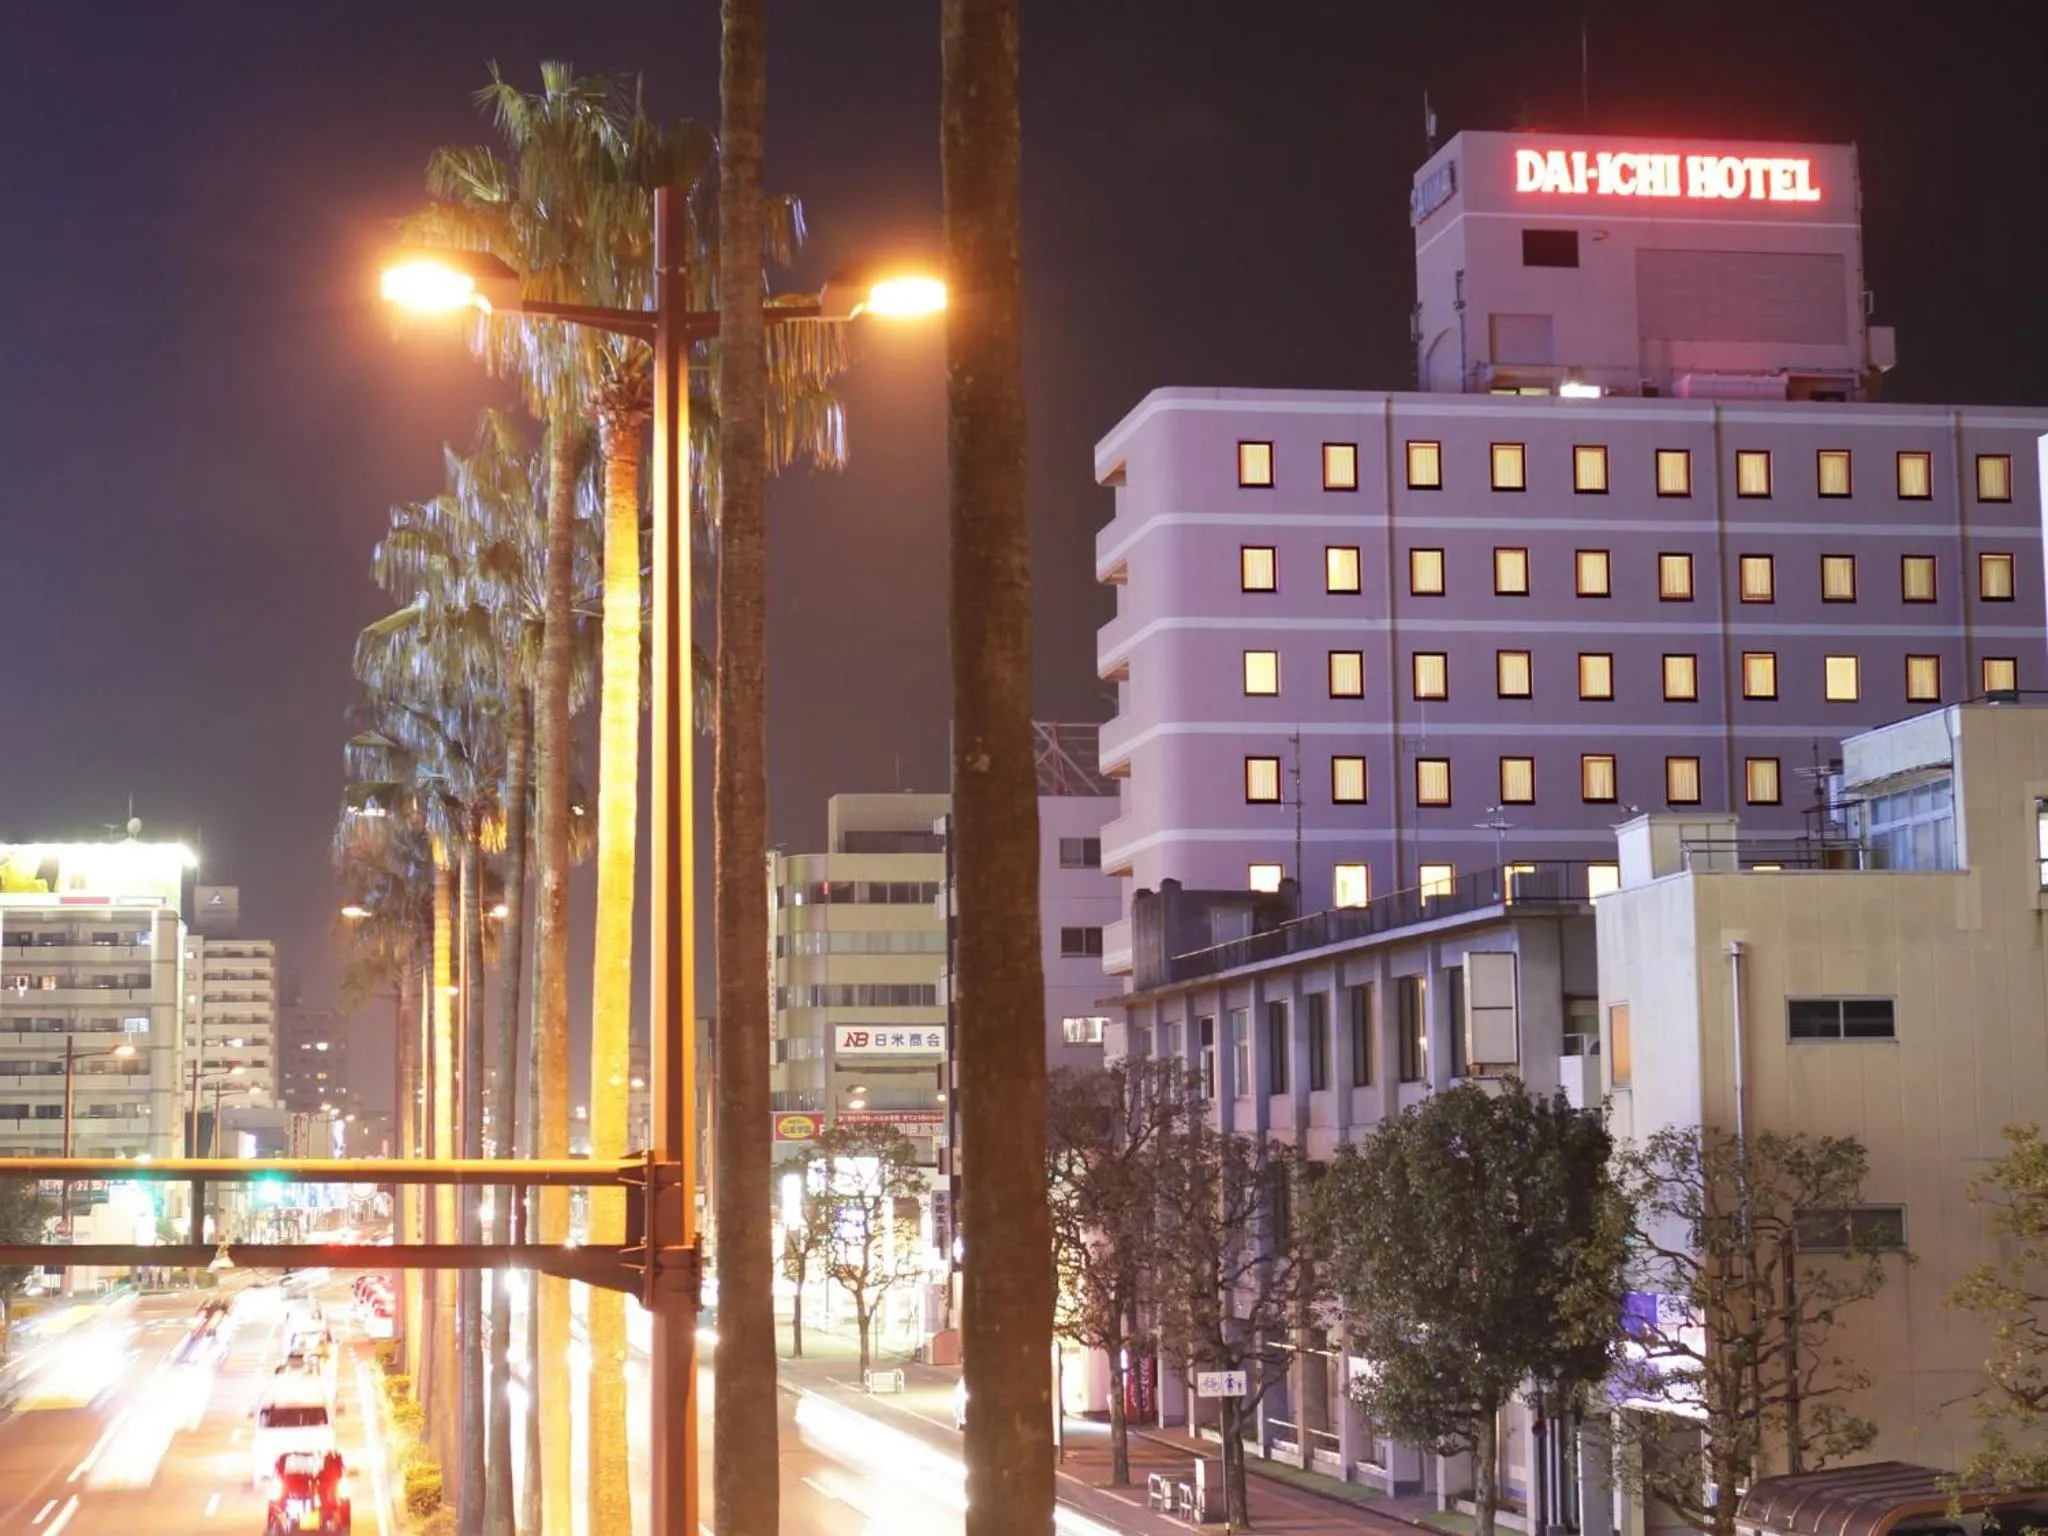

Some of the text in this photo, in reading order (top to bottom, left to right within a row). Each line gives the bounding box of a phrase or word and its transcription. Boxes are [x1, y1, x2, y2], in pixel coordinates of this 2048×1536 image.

[1515, 149, 1821, 202] DAI-ICHI HOTEL
[874, 1032, 941, 1048] 日米商会
